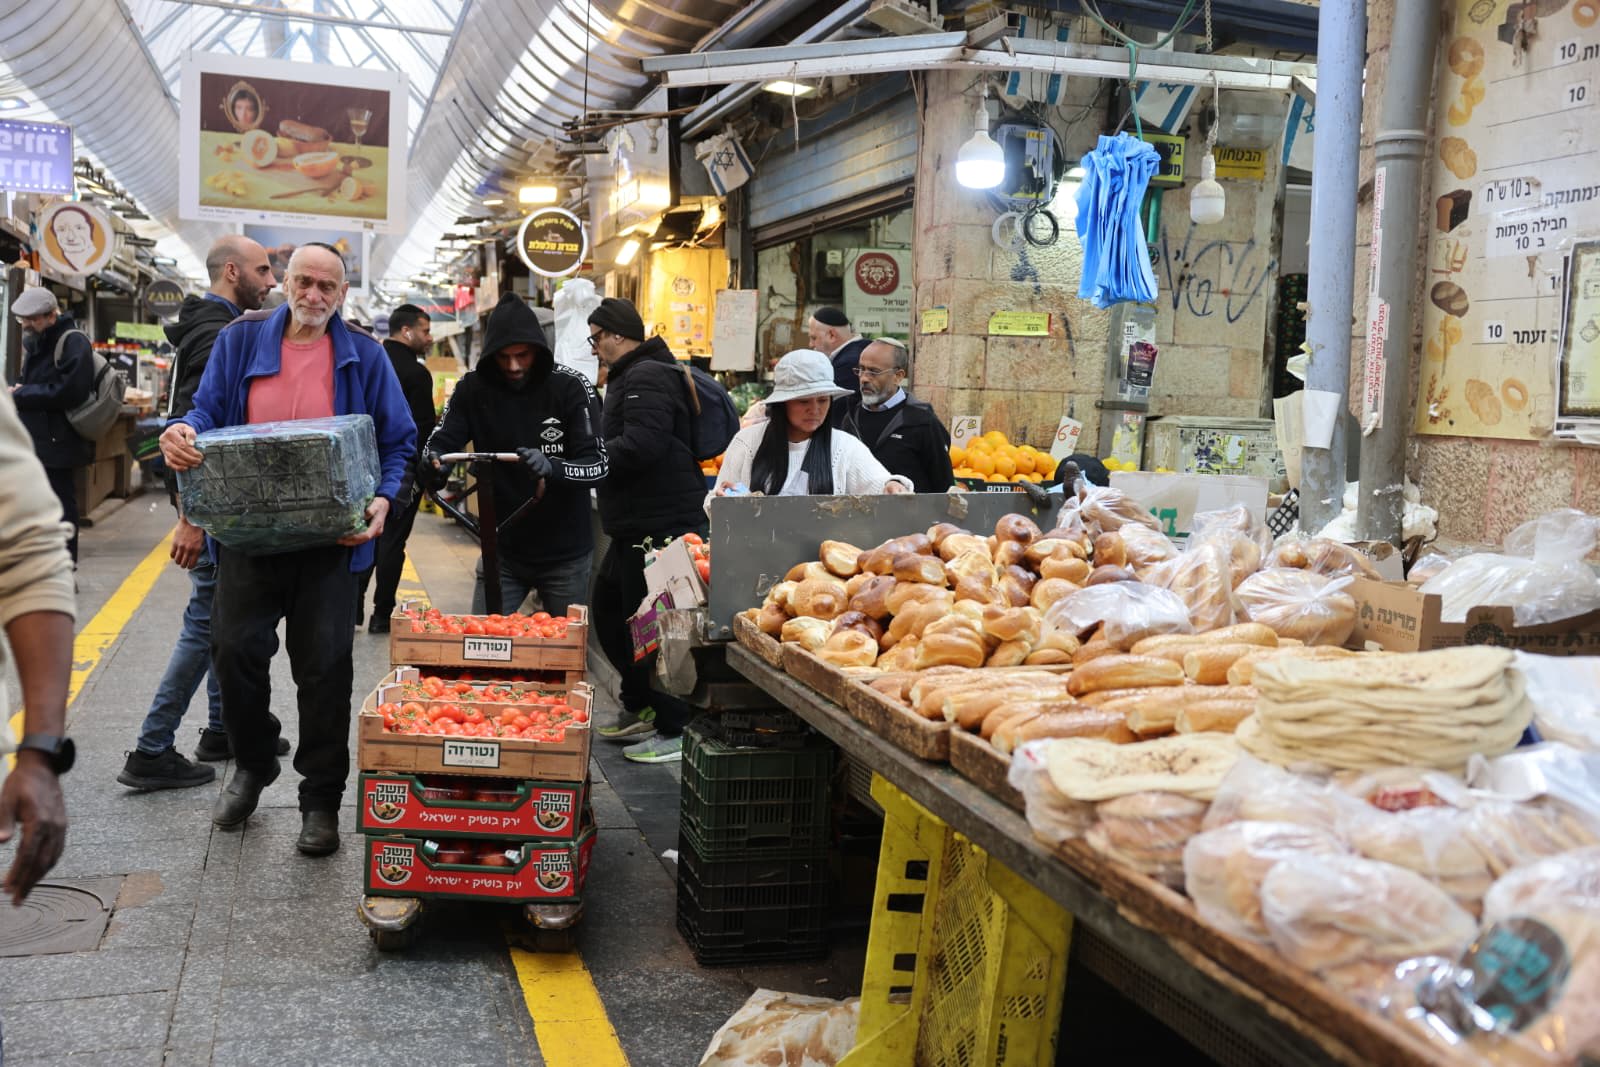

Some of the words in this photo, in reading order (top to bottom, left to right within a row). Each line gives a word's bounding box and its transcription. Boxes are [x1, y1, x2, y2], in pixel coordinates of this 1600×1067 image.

[1560, 42, 1577, 60] 10
[1569, 86, 1586, 103] 10
[1486, 180, 1507, 202] ש"ח
[1510, 178, 1522, 198] 10
[1495, 222, 1529, 238] פיתות
[1532, 216, 1568, 234] חבילה
[1515, 236, 1530, 250] 10
[1537, 237, 1546, 247] ב
[1487, 324, 1503, 339] 10
[1513, 329, 1548, 345] זעתר
[541, 443, 563, 454] ICON
[565, 465, 585, 477] ICON
[468, 640, 508, 652] נטורזה
[448, 743, 495, 758] נטורזה
[418, 811, 457, 824] ישראלי
[466, 815, 499, 826] בוטיק
[501, 818, 520, 828] ירק
[424, 874, 461, 887] ישראלי
[471, 877, 502, 889] בוטיק
[505, 880, 522, 891] ירק
